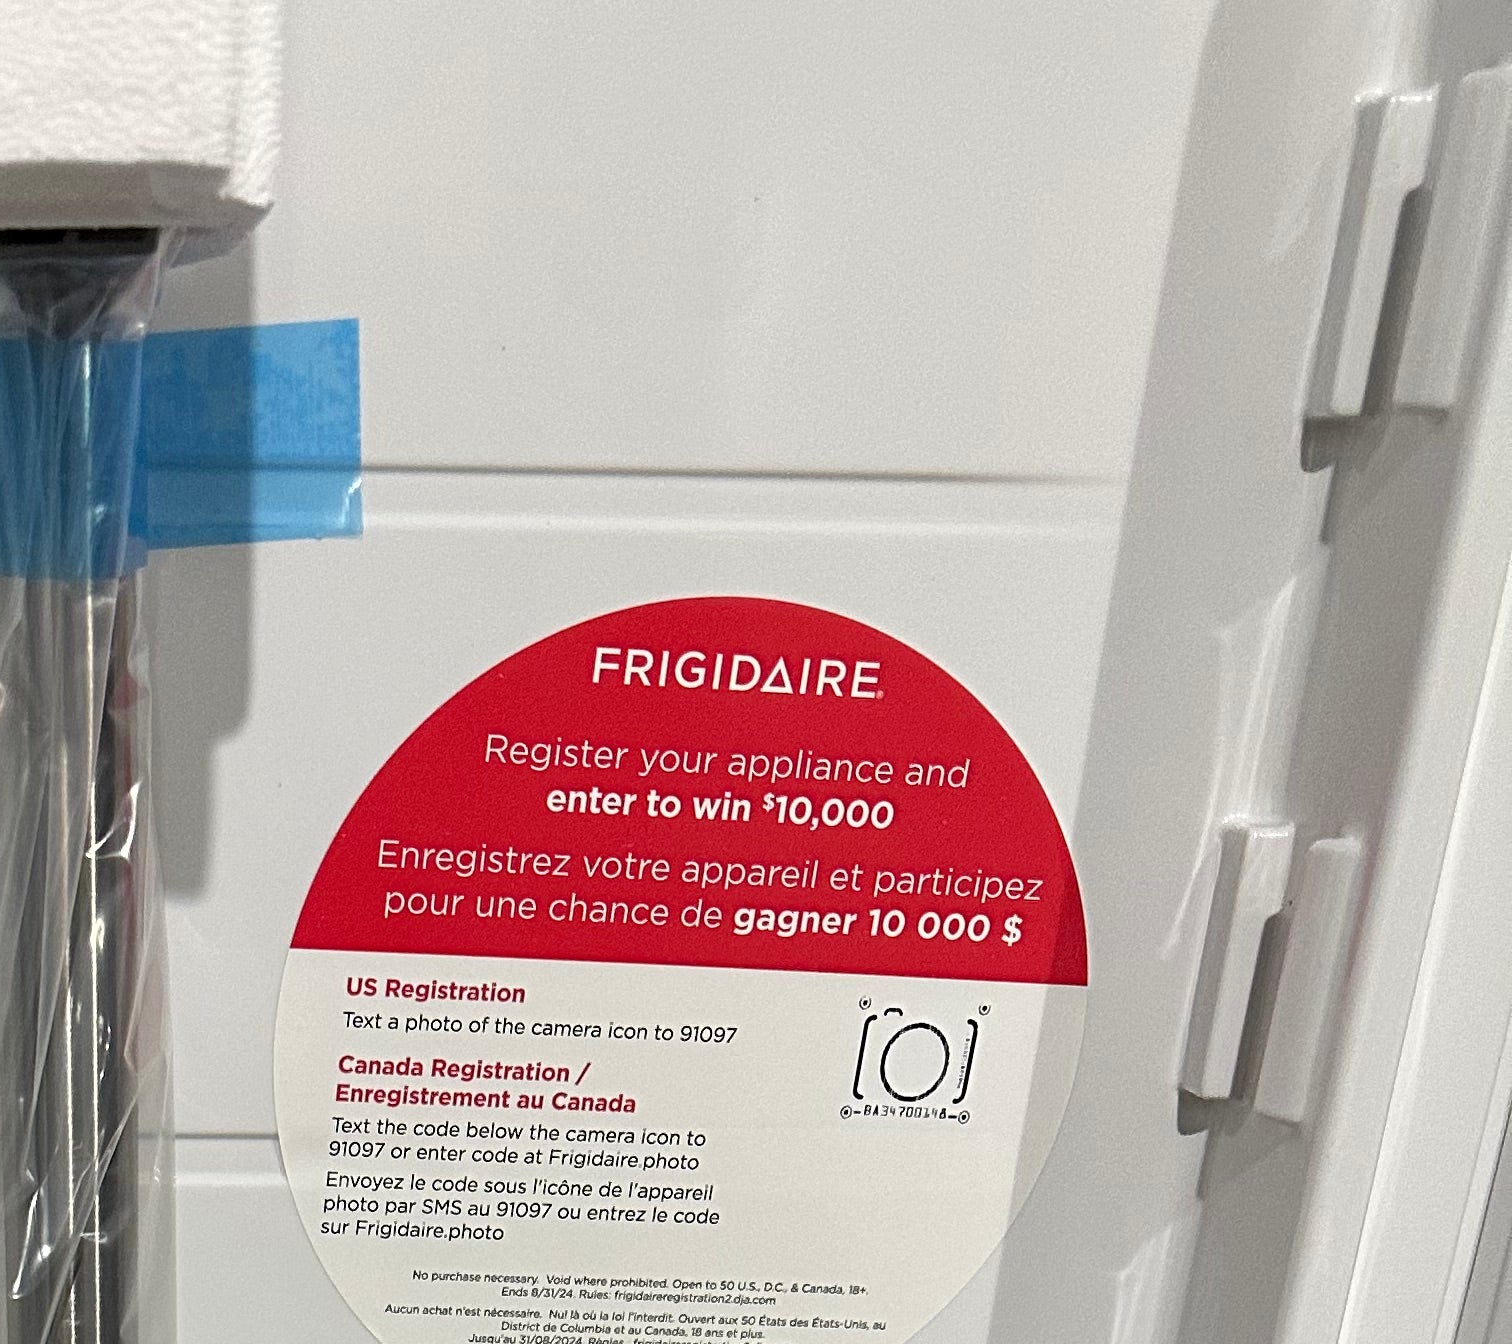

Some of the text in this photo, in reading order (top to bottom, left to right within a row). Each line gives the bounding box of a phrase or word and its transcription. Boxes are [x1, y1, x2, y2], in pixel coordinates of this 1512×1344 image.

[592, 646, 883, 698] FRIGIDAIRE
[485, 734, 970, 787] Register your appliance and
[546, 786, 893, 830] enter to win $10,000
[378, 839, 1043, 903] Enregistrez votre appareil et participez
[384, 891, 1022, 946] pour une chance de gagner 10 000 $
[346, 976, 525, 1003] US Registration
[342, 1010, 737, 1043] Text a photo of the camera icon to 91097
[338, 1055, 591, 1085] Canada Registration /
[335, 1083, 635, 1112] Enregistrement au Canada
[332, 1116, 705, 1146] Text the code below the camera icon to
[328, 1140, 699, 1171] 91097 or enter code at Frigidaire.photo
[326, 1170, 713, 1202] Envoyez le code sous l'icône de l'appareil
[323, 1197, 719, 1224] photo par SMS au 91097 ou entrez le code
[320, 1219, 503, 1241] sur Frigidaire.photo
[412, 1269, 428, 1280] No
[431, 1271, 481, 1282] purchase
[546, 1274, 571, 1285] Void
[573, 1275, 607, 1286] where
[672, 1278, 702, 1290] Open
[705, 1280, 716, 1290] to
[719, 1280, 734, 1290] 50
[790, 1283, 798, 1292] &
[801, 1283, 844, 1294] Canada,
